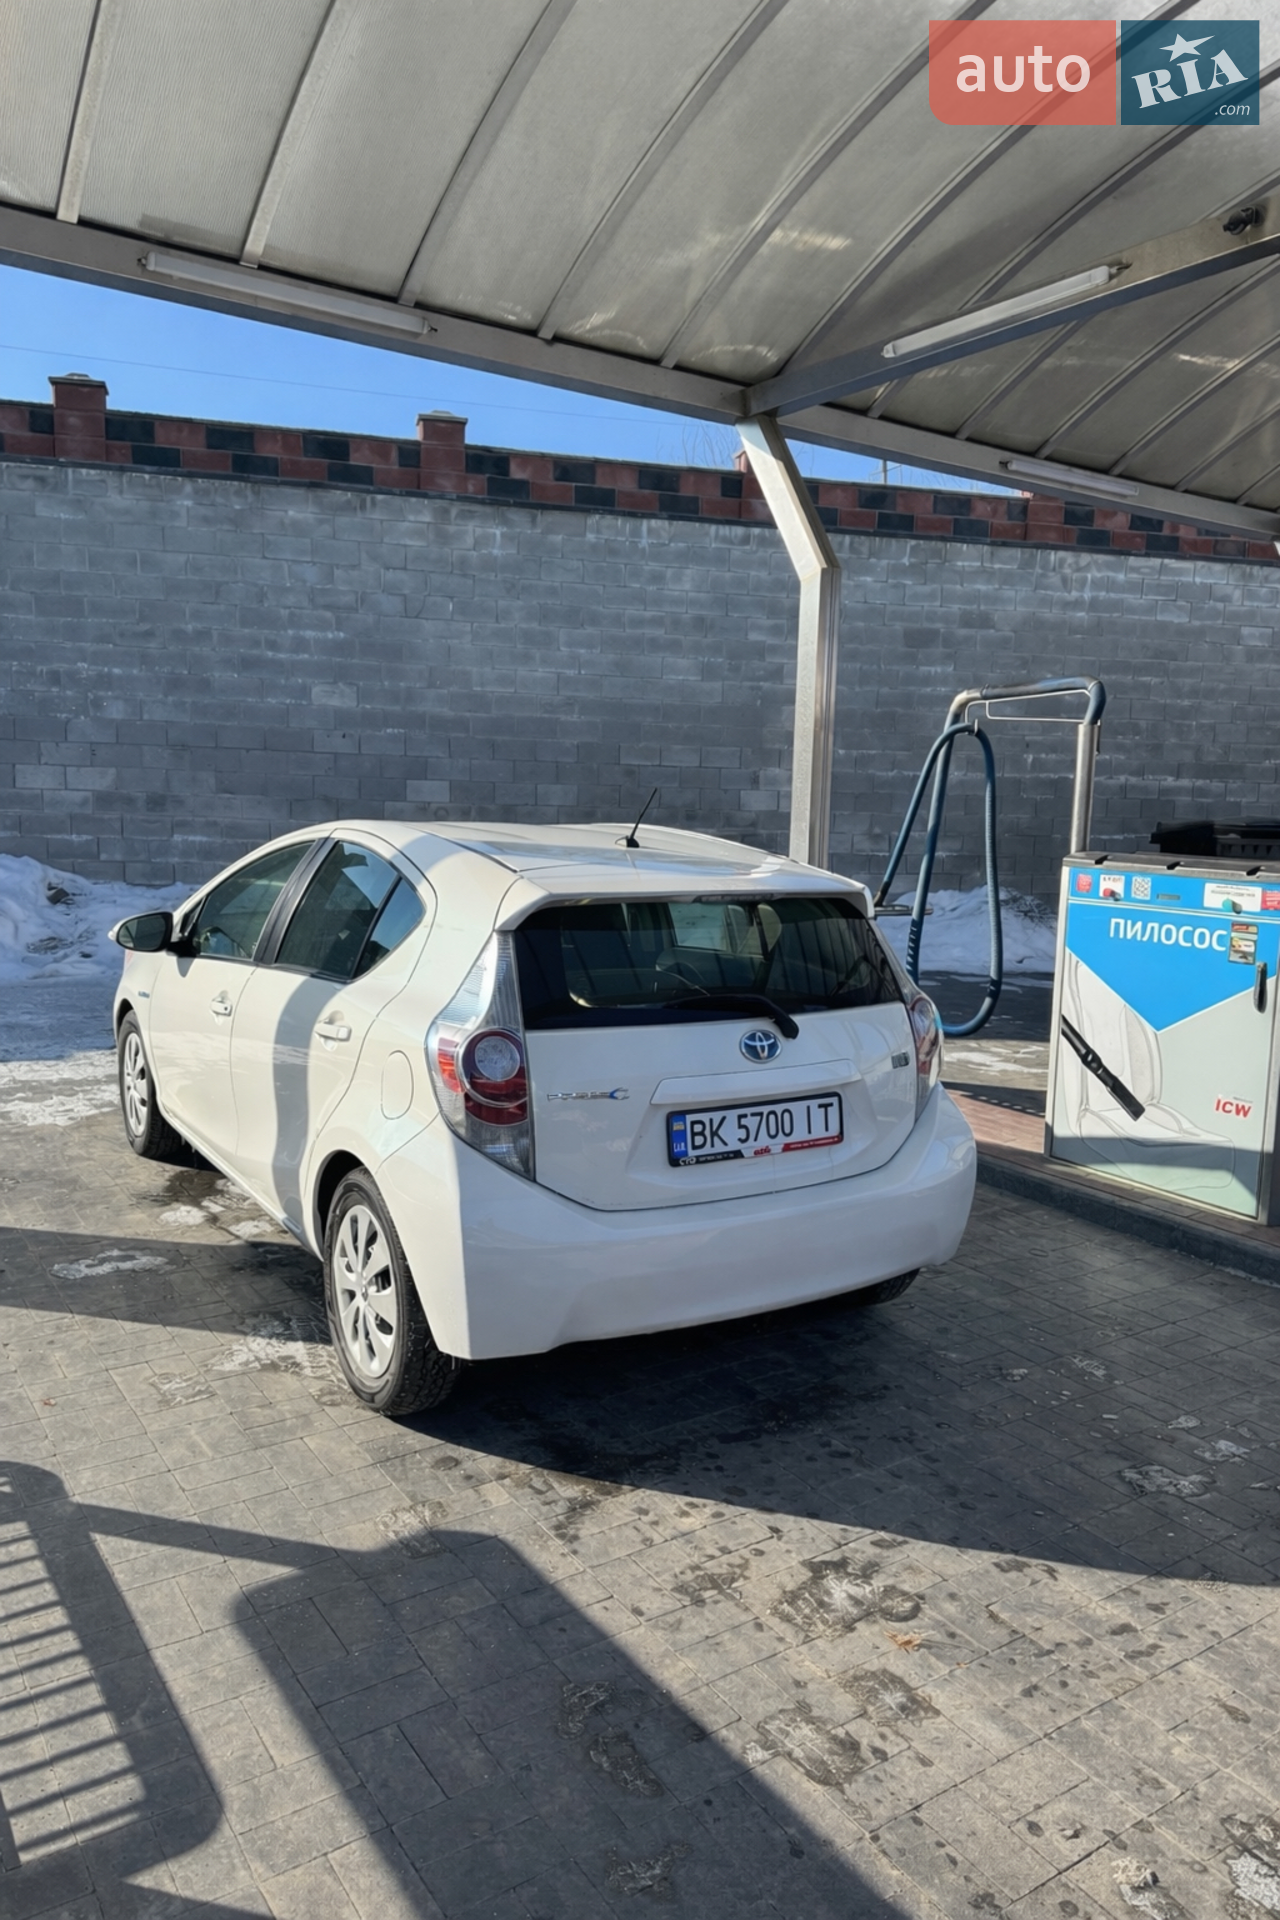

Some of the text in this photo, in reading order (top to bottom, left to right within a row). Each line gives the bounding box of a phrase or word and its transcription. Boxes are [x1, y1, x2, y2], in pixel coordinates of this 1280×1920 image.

[1109, 917, 1229, 951] ПИЛОСОС
[1215, 1098, 1252, 1118] ICW
[690, 1102, 835, 1151] BK 5700 IT
